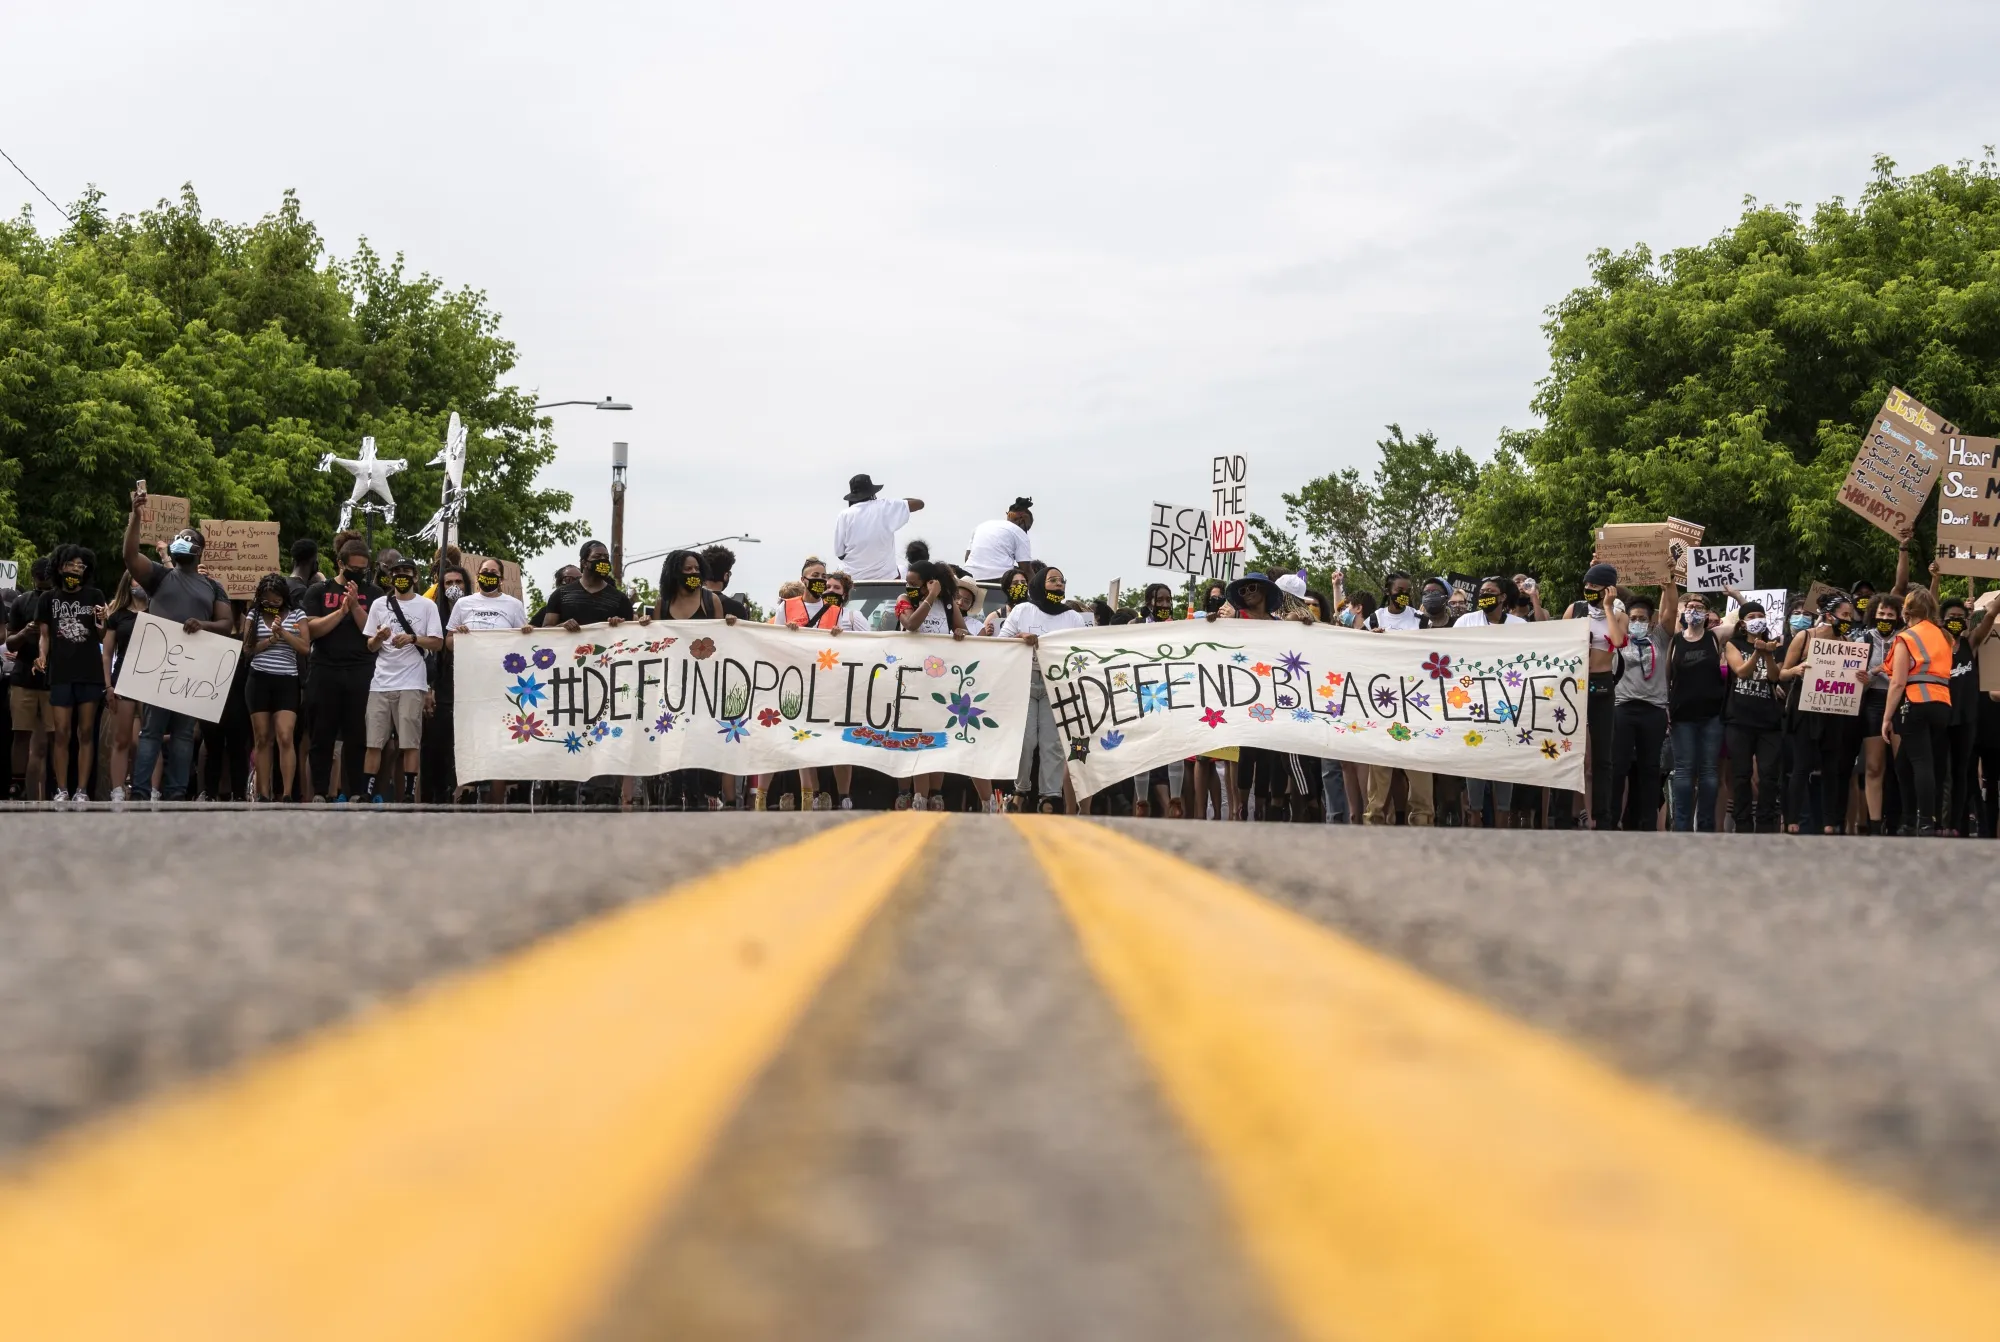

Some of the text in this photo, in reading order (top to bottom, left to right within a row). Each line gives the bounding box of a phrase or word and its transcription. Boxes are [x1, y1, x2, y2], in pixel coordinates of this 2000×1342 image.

[1886, 389, 1936, 435] Justice
[1948, 438, 1991, 466] Hear
[1213, 455, 1246, 484] END
[1905, 453, 1931, 477] Floyd
[1943, 471, 1979, 498] See
[1212, 485, 1246, 516] THE
[1881, 485, 1900, 506] Rice
[205, 524, 221, 538] You
[1176, 508, 1211, 539] CA
[1690, 528, 1701, 537] FOR
[205, 541, 260, 550] FREEDOM from
[1212, 520, 1245, 553] MPD
[204, 551, 231, 560] PEACE
[1148, 529, 1241, 581] BREATHE
[1693, 547, 1752, 567] BLACK
[0, 563, 17, 580] ND
[227, 574, 255, 582] UNLESS
[1707, 564, 1732, 574] Lives
[1452, 579, 1477, 591] MELT
[1812, 640, 1869, 660] BLACKNESS
[1815, 658, 1862, 669] SHOULD NOT
[1825, 670, 1835, 678] BE
[546, 656, 923, 733] #DEFUNDPOLICE
[1815, 678, 1856, 695] DEATH
[1804, 691, 1858, 708] SENTENCE
